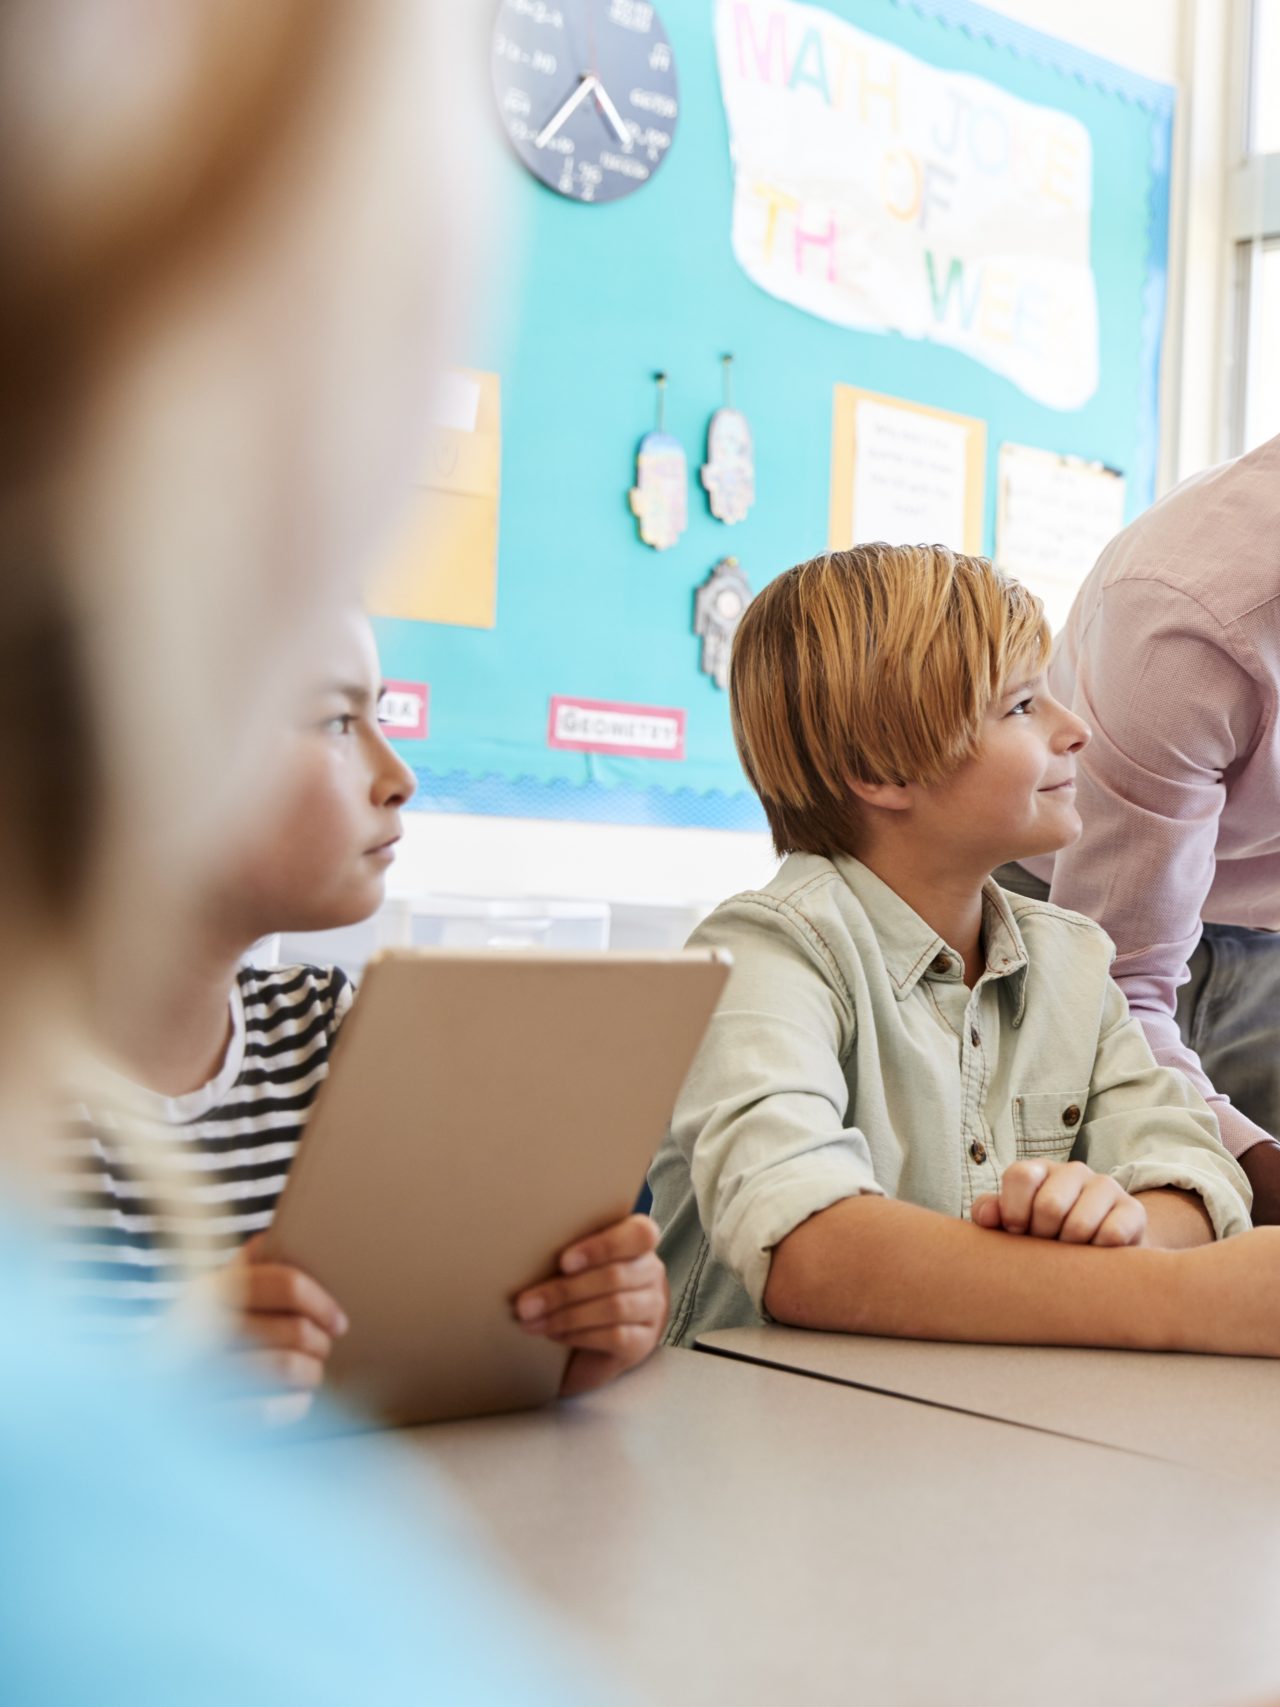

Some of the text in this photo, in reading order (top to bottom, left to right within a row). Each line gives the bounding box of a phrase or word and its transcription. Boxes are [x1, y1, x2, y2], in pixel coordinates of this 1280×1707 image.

[732, 2, 902, 135] MATH
[879, 145, 958, 231] OF
[752, 179, 1077, 363] TH WEE
